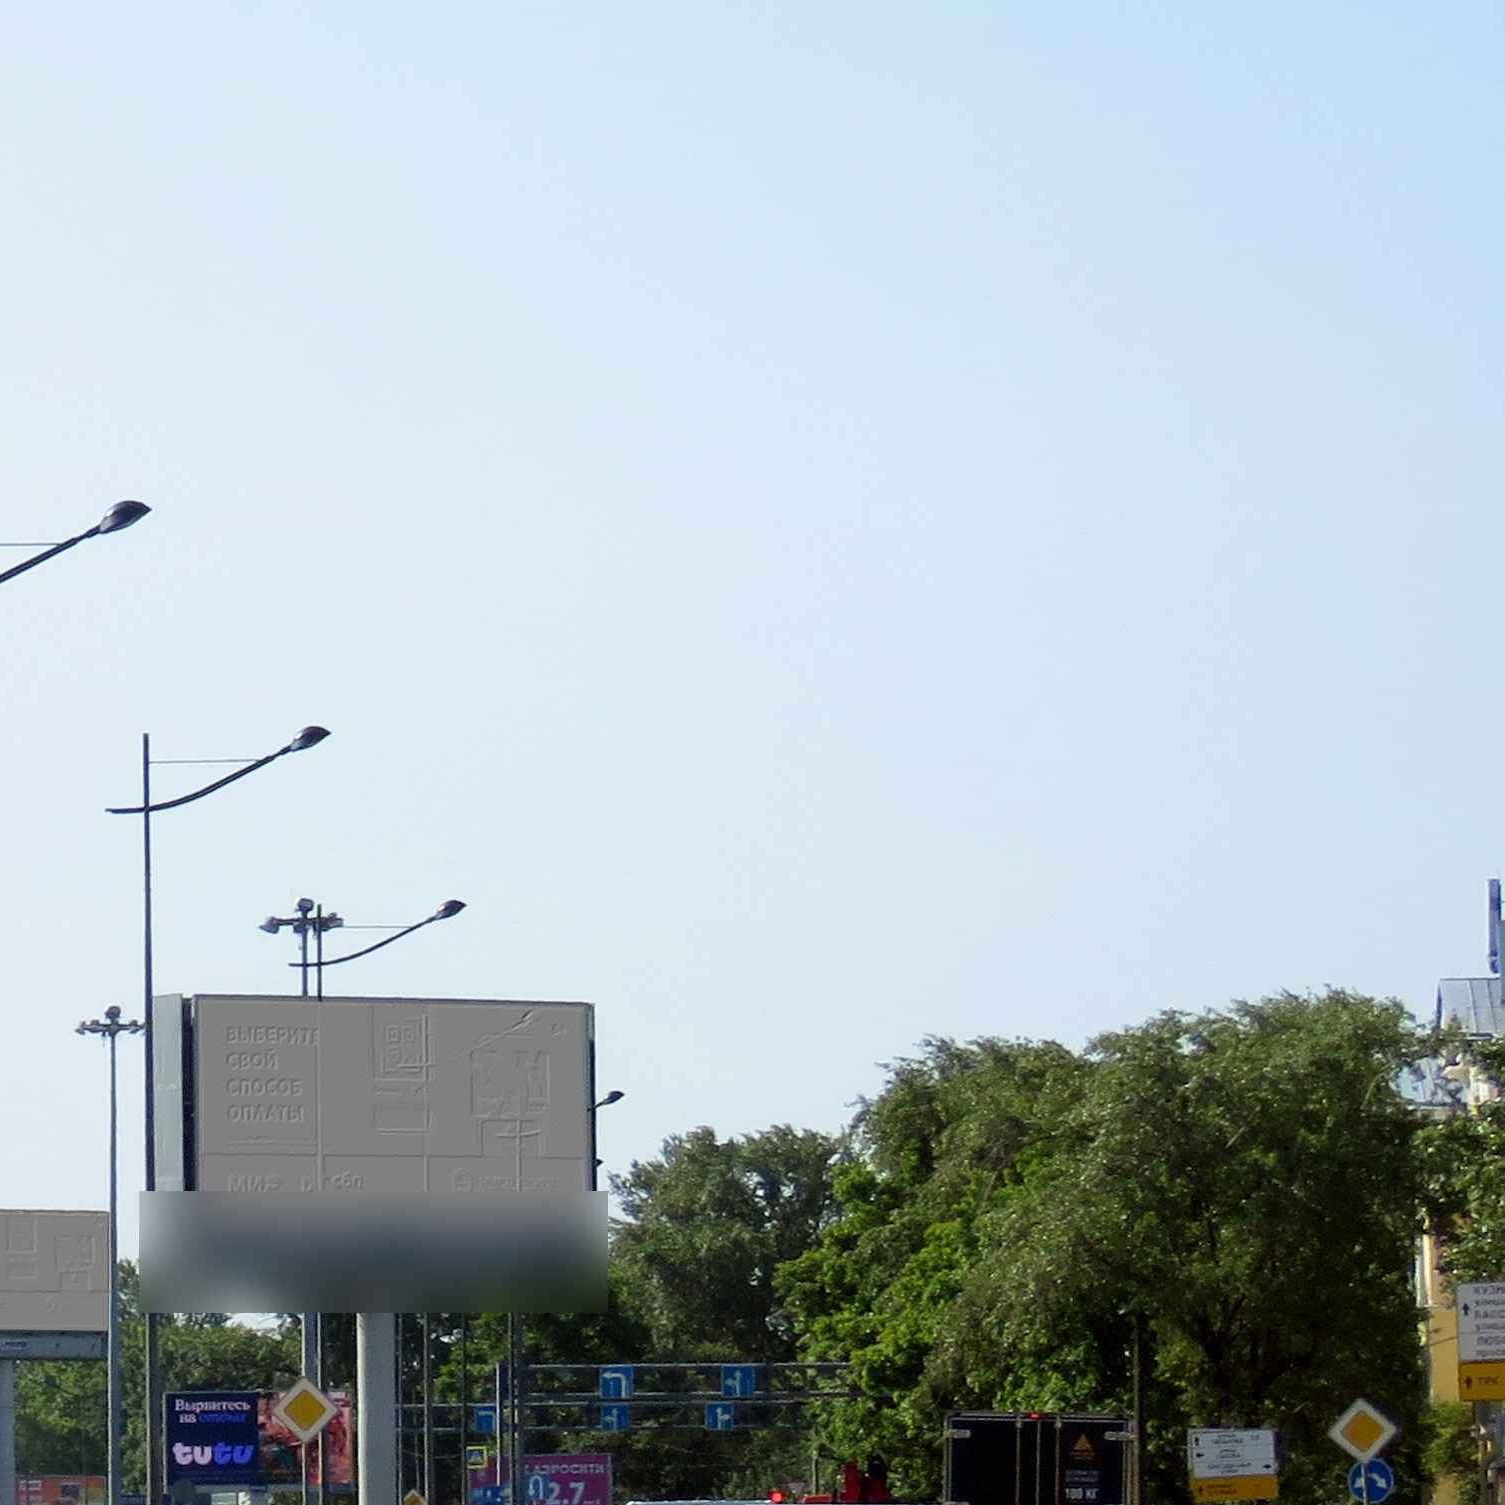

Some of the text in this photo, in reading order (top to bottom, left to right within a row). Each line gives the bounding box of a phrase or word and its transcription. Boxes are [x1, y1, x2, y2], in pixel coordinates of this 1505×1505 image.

[226, 1050, 279, 1069] СВОЙ
[226, 1078, 303, 1096] СПОСОБ
[228, 1104, 304, 1122] ОПЛАТЫ
[172, 1441, 254, 1466] tutu
